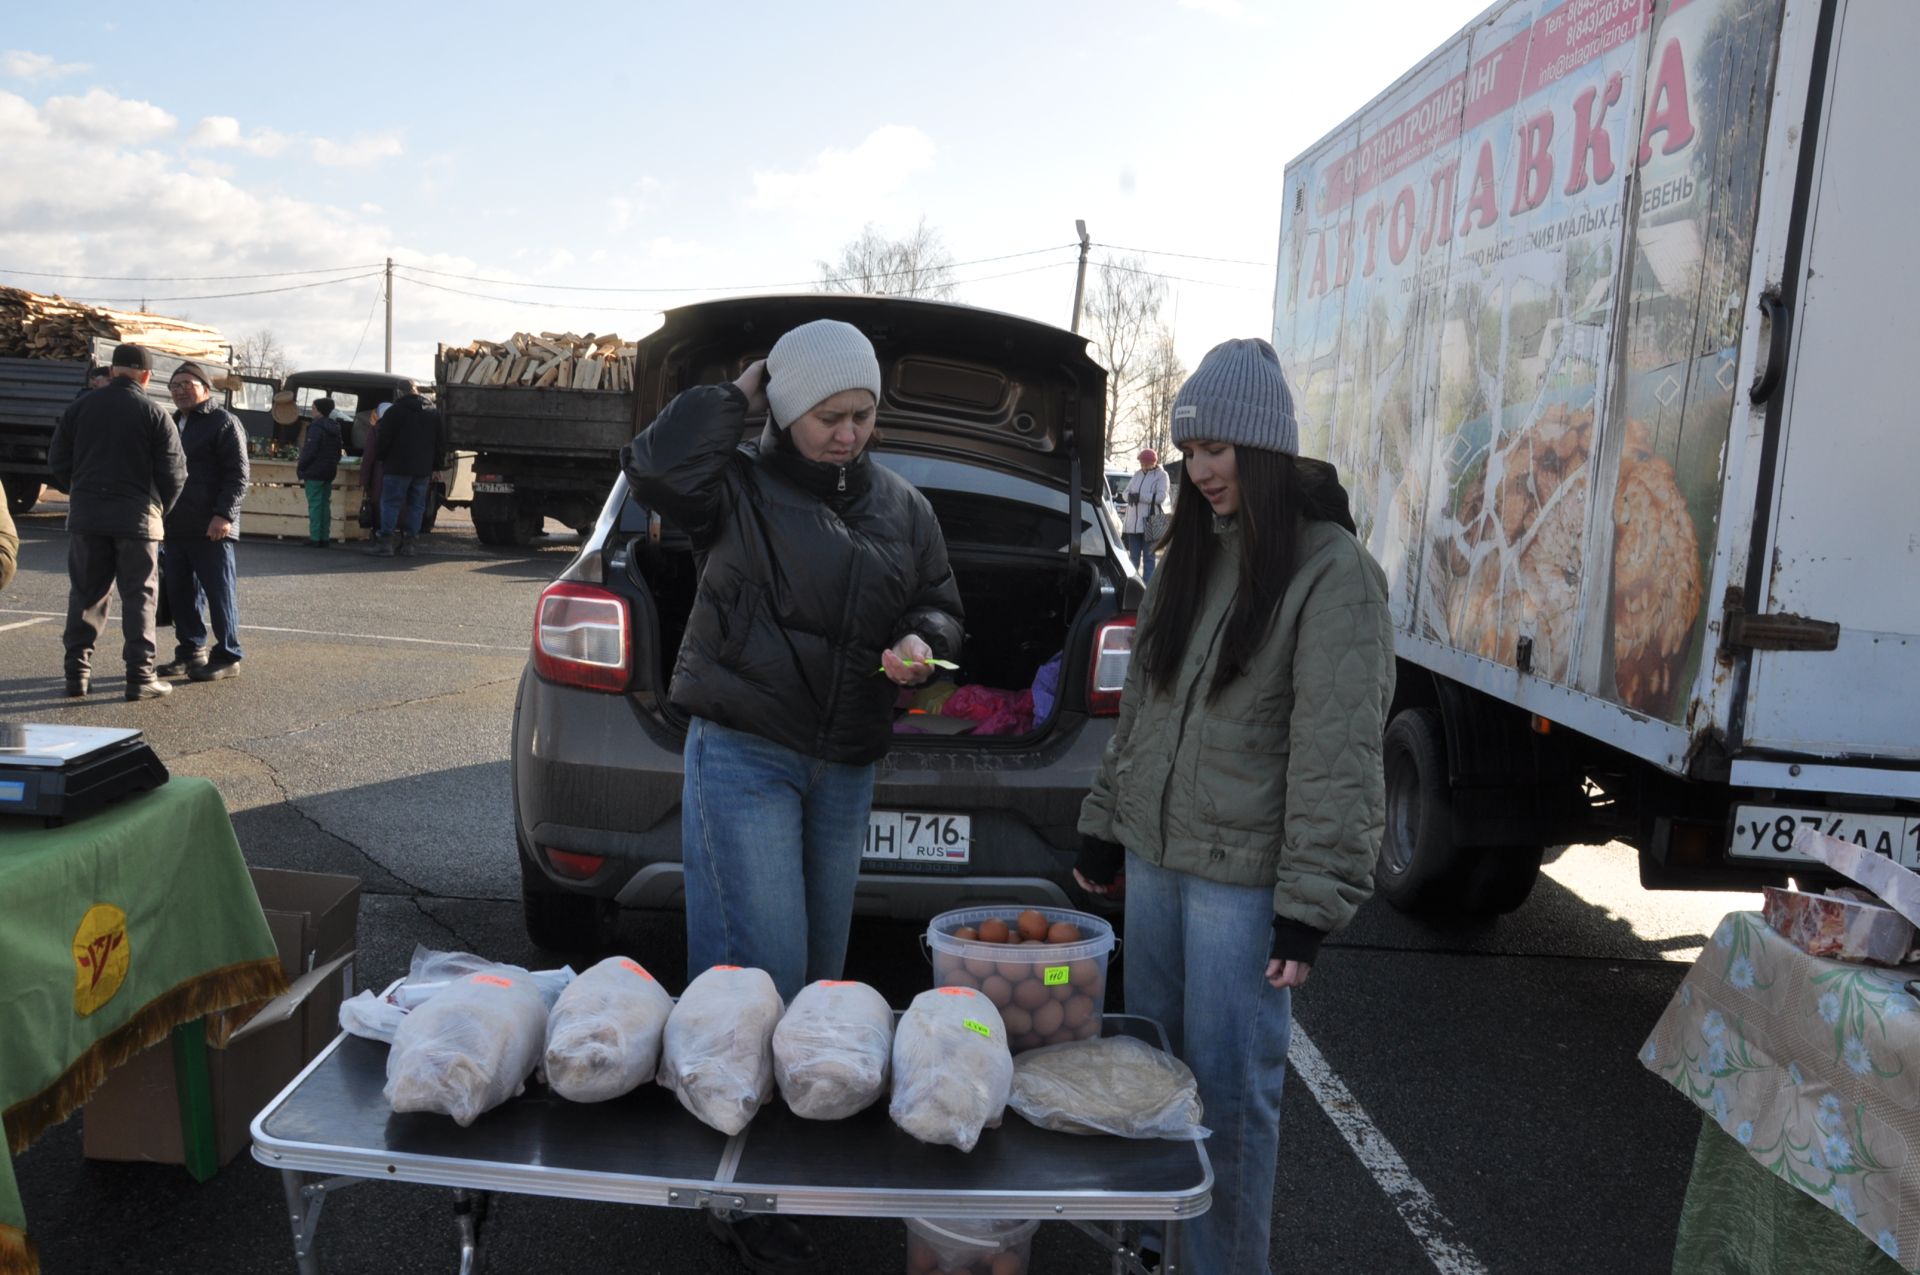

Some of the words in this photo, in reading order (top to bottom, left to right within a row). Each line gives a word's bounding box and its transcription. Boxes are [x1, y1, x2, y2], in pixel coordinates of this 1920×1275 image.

[1307, 37, 1696, 299] АВТОЛАВКА
[1556, 205, 1609, 243] МАЛЫХ
[904, 815, 960, 846] 716
[916, 846, 945, 858] RUS
